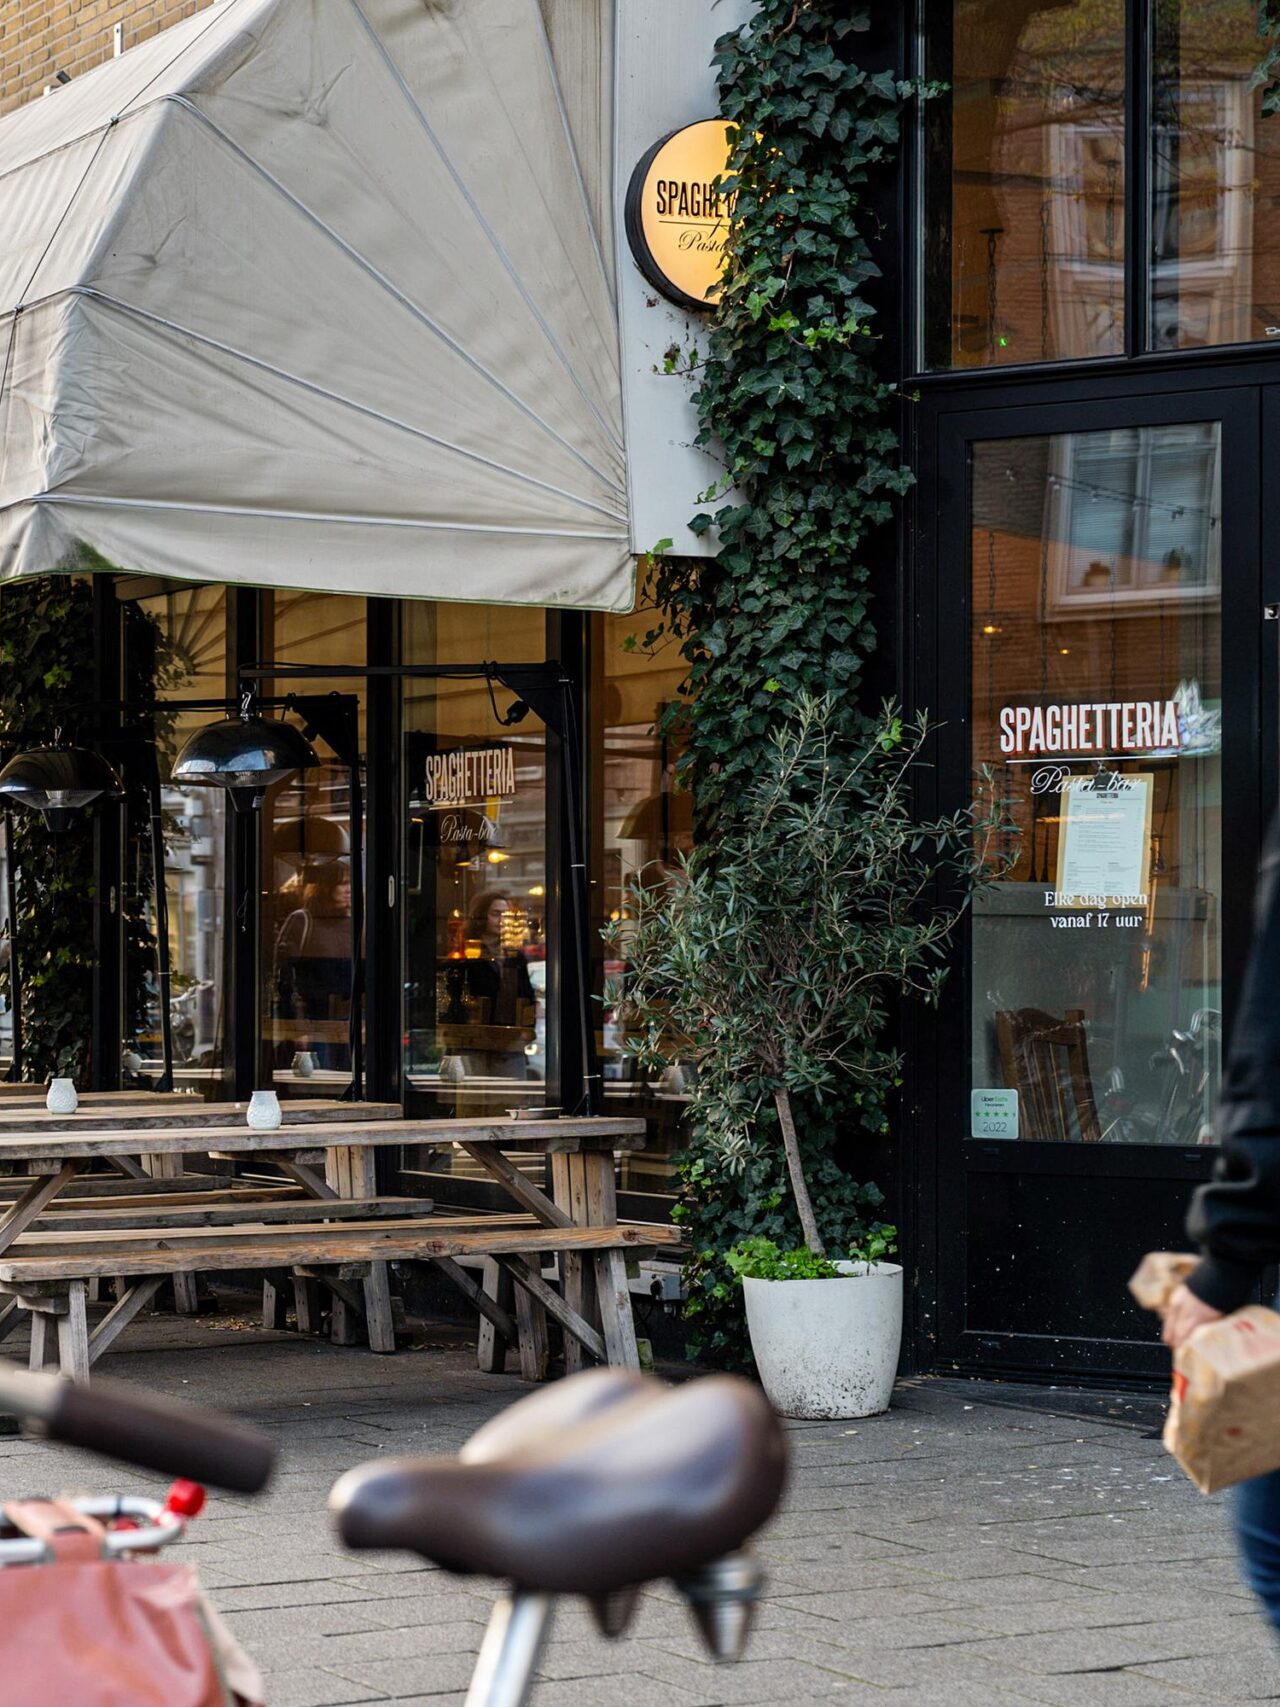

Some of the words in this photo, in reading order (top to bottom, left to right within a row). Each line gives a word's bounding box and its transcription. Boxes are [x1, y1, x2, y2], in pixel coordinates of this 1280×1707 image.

[1000, 701, 1180, 754] SPAGHETTERIA
[426, 747, 515, 800] SPAGHETTERIA
[1043, 891, 1074, 906] Elke
[1080, 892, 1107, 909] dag
[1112, 894, 1148, 909] open
[1050, 912, 1093, 928] vanaf
[1097, 912, 1110, 928] 17
[1115, 915, 1143, 928] uur
[983, 1121, 1008, 1132] 2022
